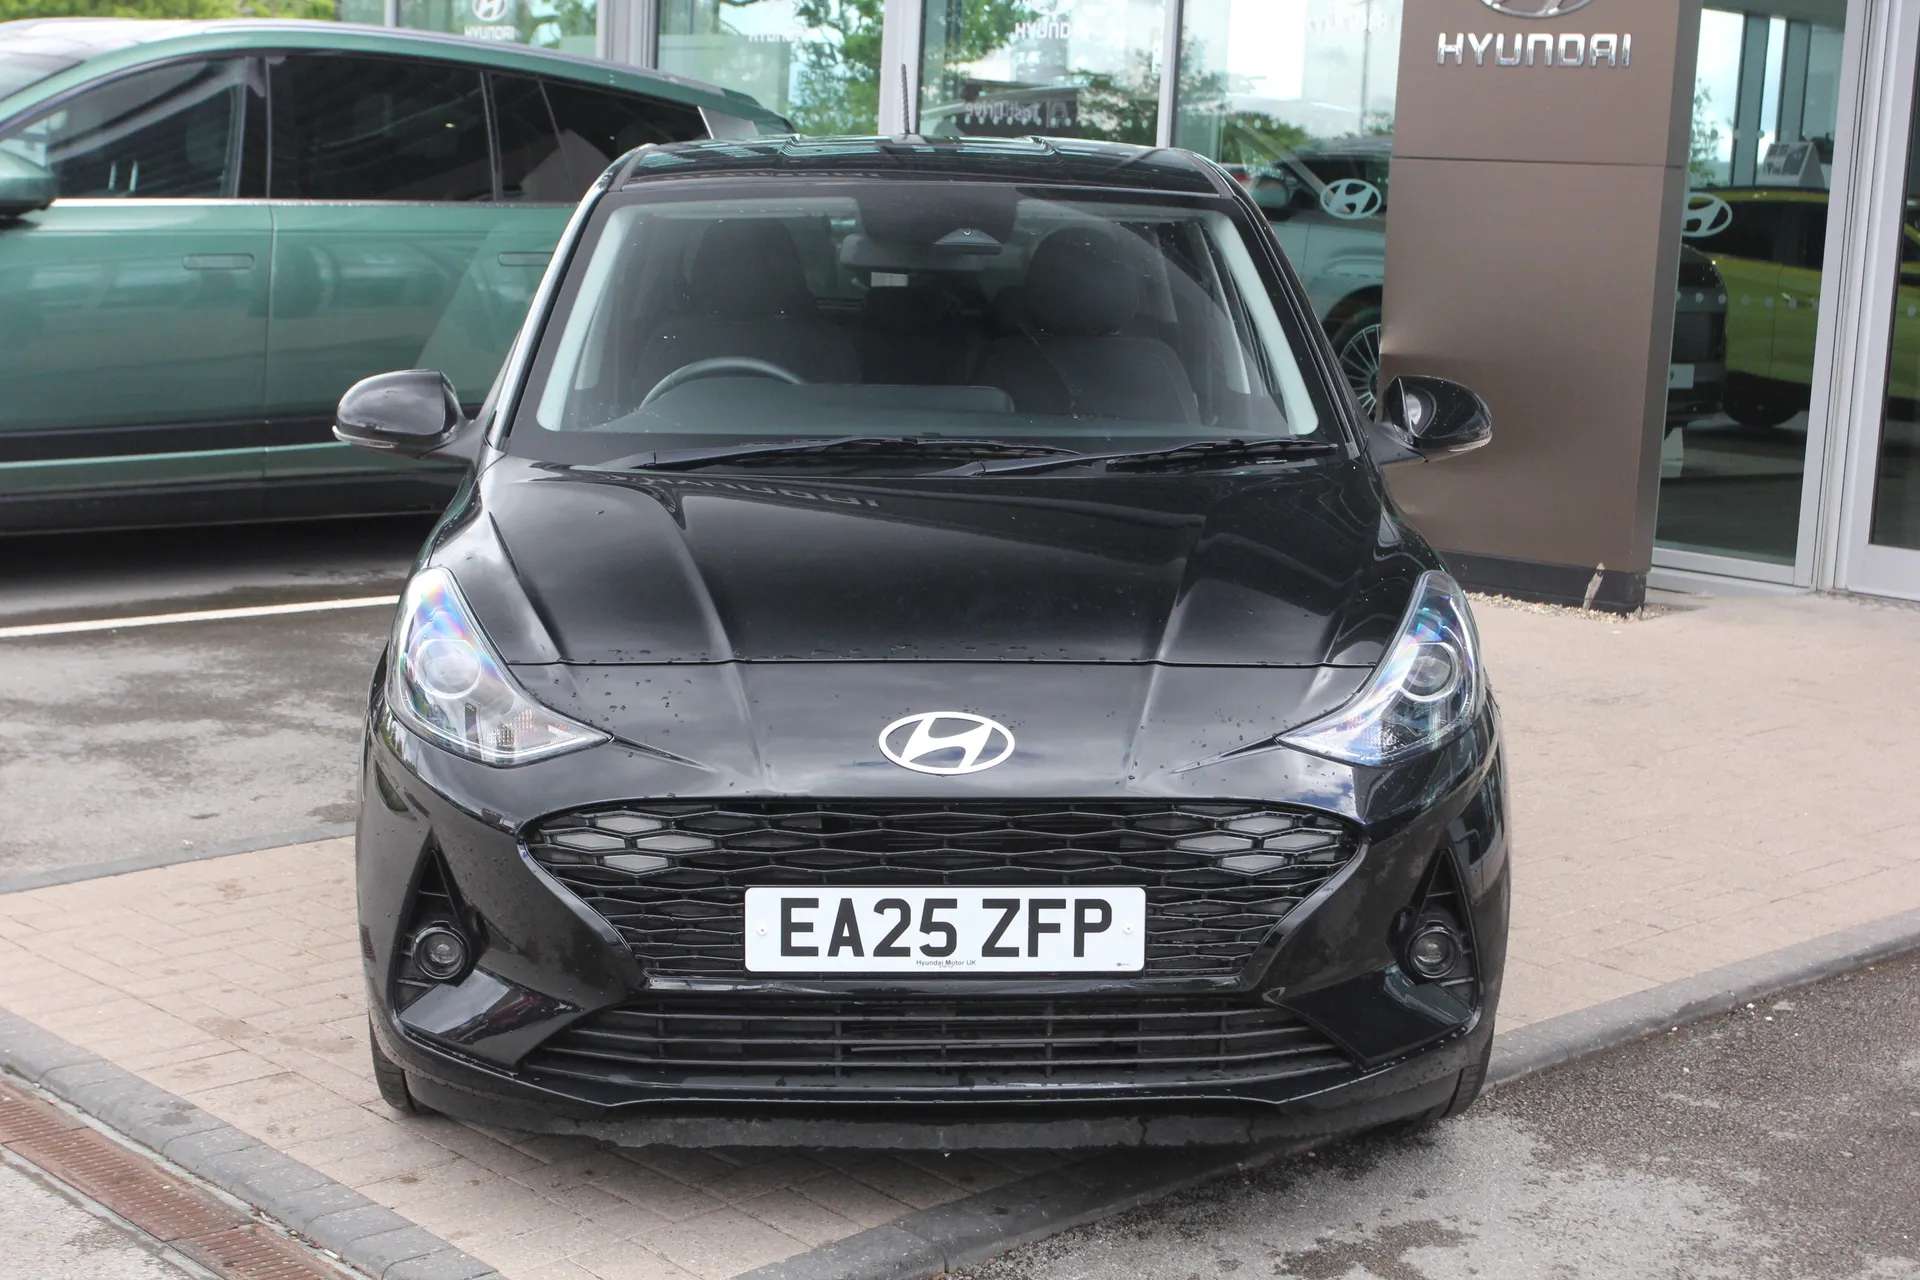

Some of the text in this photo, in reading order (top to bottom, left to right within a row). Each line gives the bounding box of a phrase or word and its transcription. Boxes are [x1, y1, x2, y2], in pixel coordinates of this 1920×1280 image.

[1014, 22, 1073, 39] HYUND
[1436, 32, 1632, 67] HYUNDAI
[780, 897, 1113, 958] EA25 ZFP
